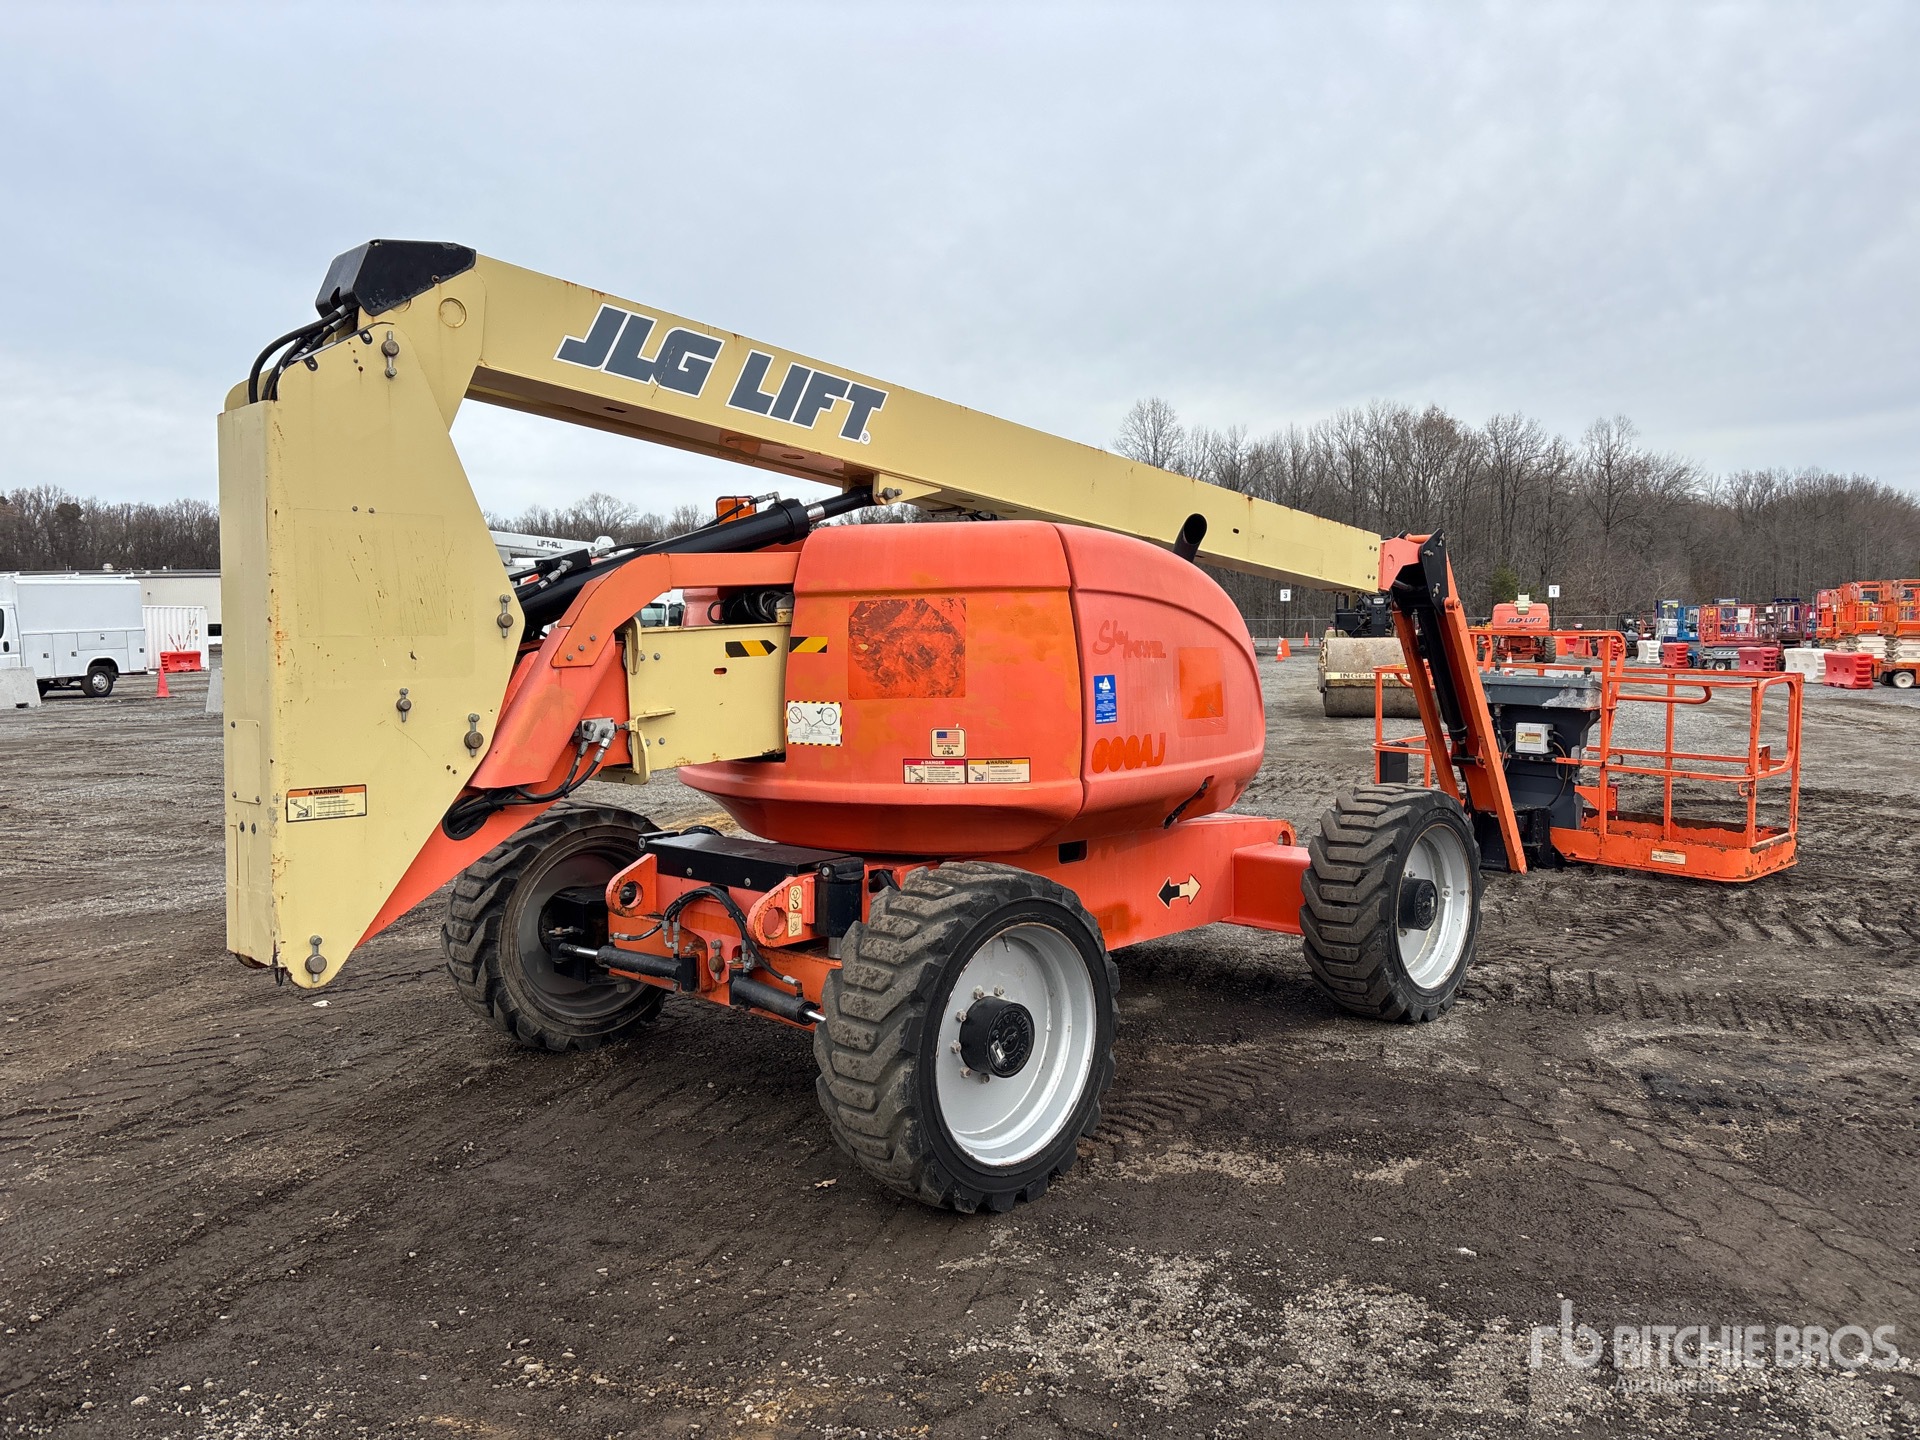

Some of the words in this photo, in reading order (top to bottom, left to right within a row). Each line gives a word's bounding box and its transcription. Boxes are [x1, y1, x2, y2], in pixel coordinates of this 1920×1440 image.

[553, 302, 726, 399] JLG
[725, 348, 890, 444] LIFT
[537, 540, 563, 549] LIFT-ALL
